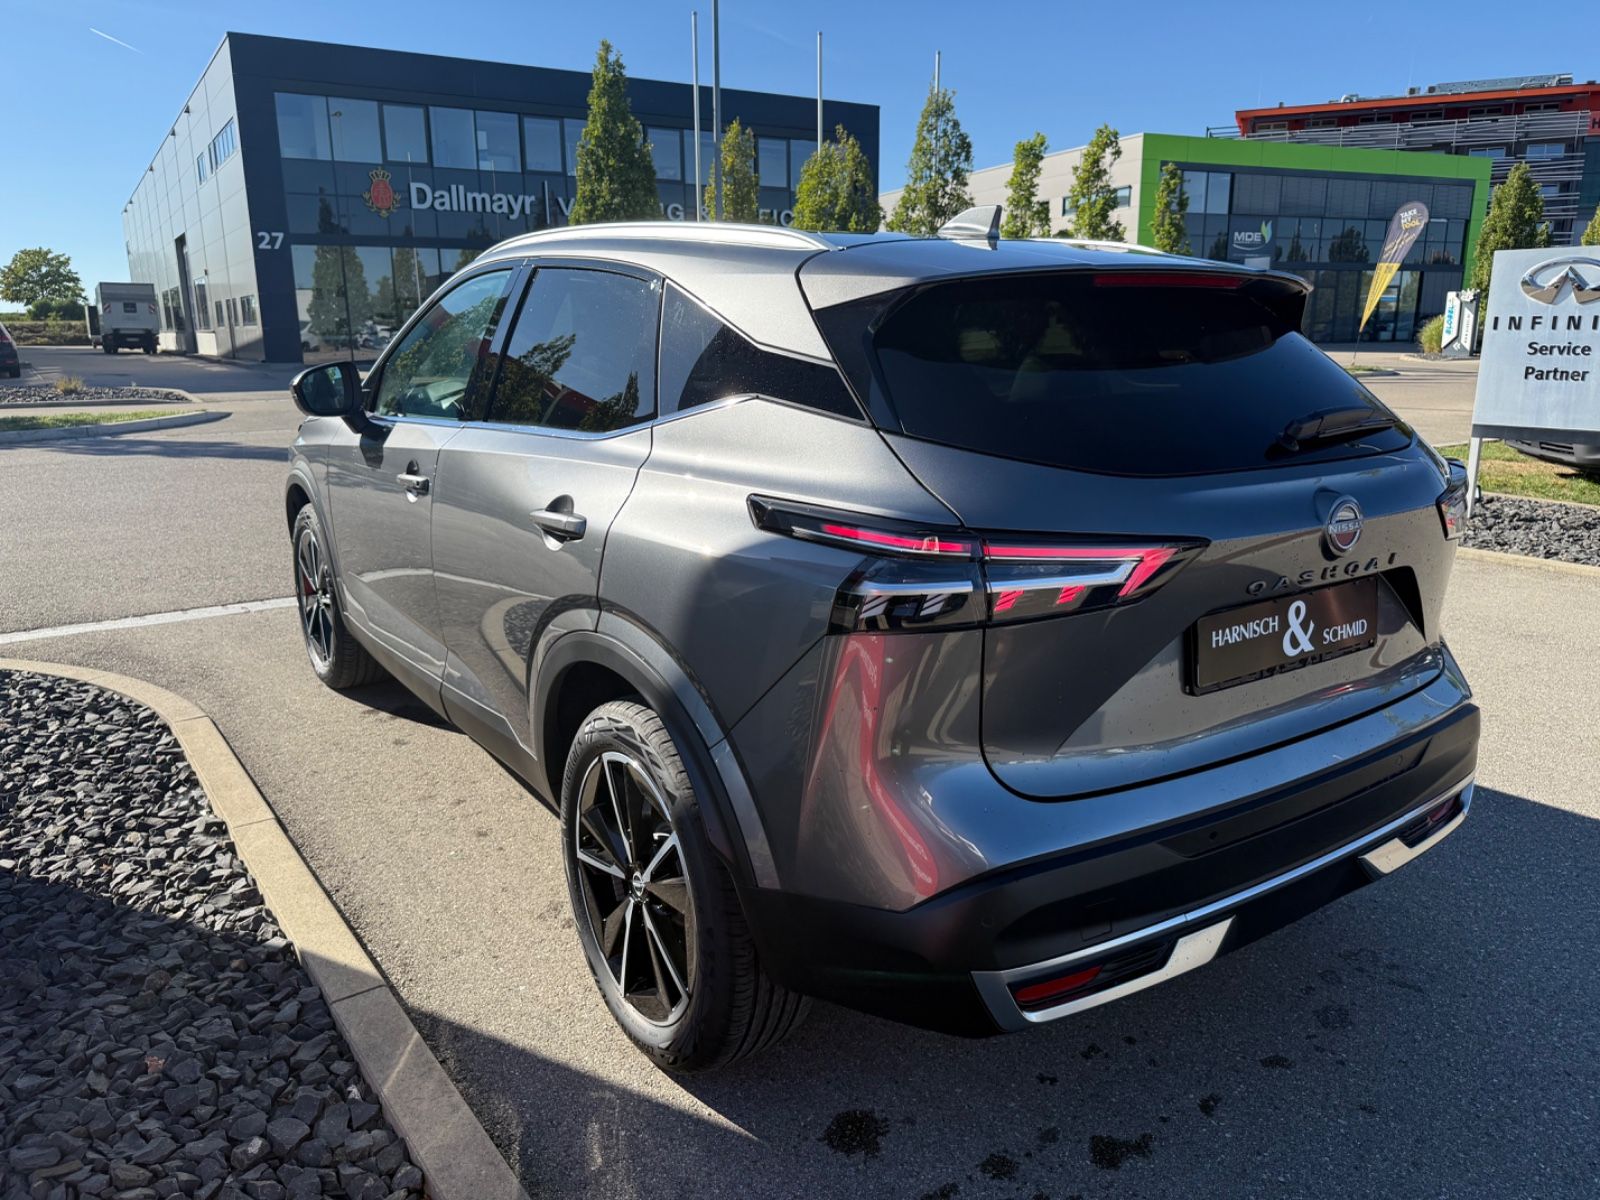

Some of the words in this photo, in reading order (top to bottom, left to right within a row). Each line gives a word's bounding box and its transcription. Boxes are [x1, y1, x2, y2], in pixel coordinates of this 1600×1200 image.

[409, 181, 536, 221] Dallmayr
[257, 232, 284, 249] 27
[1234, 231, 1262, 242] MDE
[1527, 341, 1592, 356] Service
[1524, 365, 1590, 382] Partner
[1246, 552, 1396, 597] QASHQAI
[1211, 615, 1279, 648] HARNISCH
[1282, 600, 1315, 657] &
[1322, 618, 1368, 645] SCHMID
